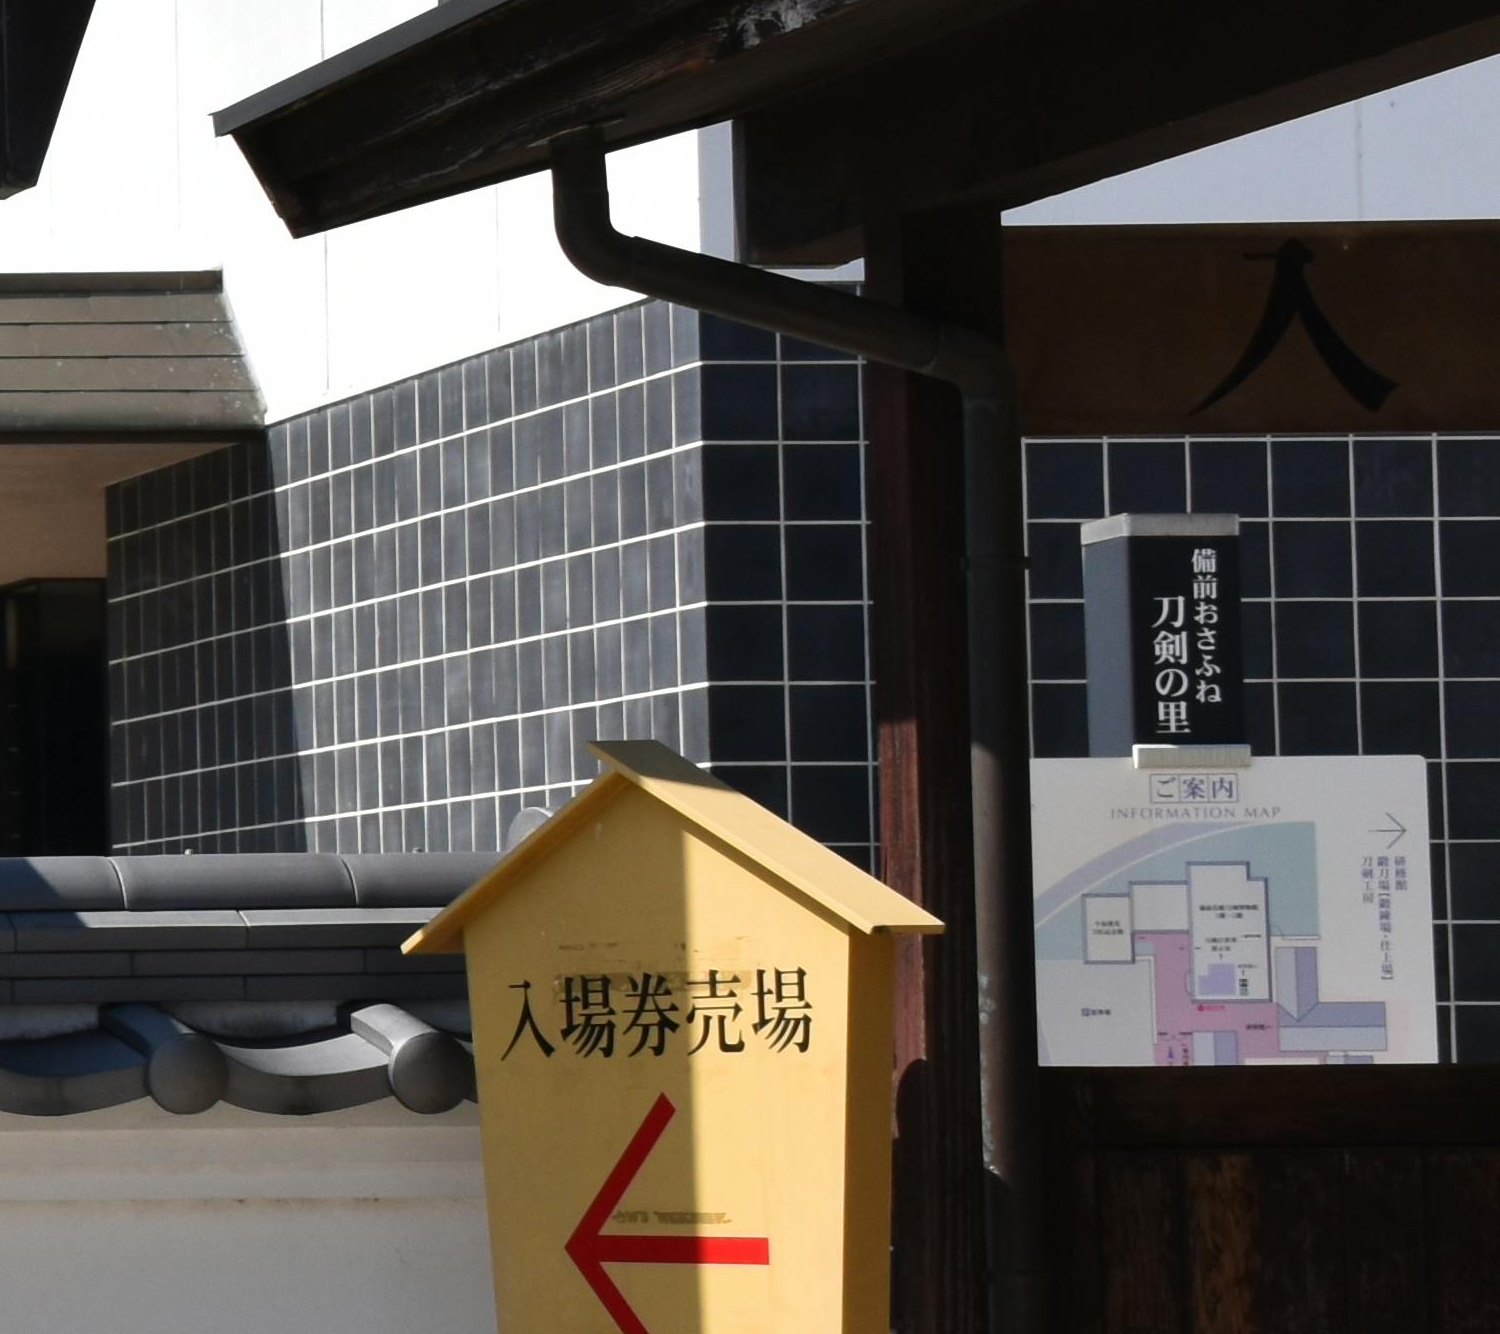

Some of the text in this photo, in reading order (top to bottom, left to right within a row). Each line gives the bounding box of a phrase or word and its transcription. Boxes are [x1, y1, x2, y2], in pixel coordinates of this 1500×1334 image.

[1151, 595, 1192, 734] 刀剣の里
[1190, 548, 1223, 704] 備前おさふね
[1111, 806, 1281, 820] INFORMATION MAP
[1156, 776, 1234, 800] ご案内
[500, 965, 814, 1062] 入場券売場
